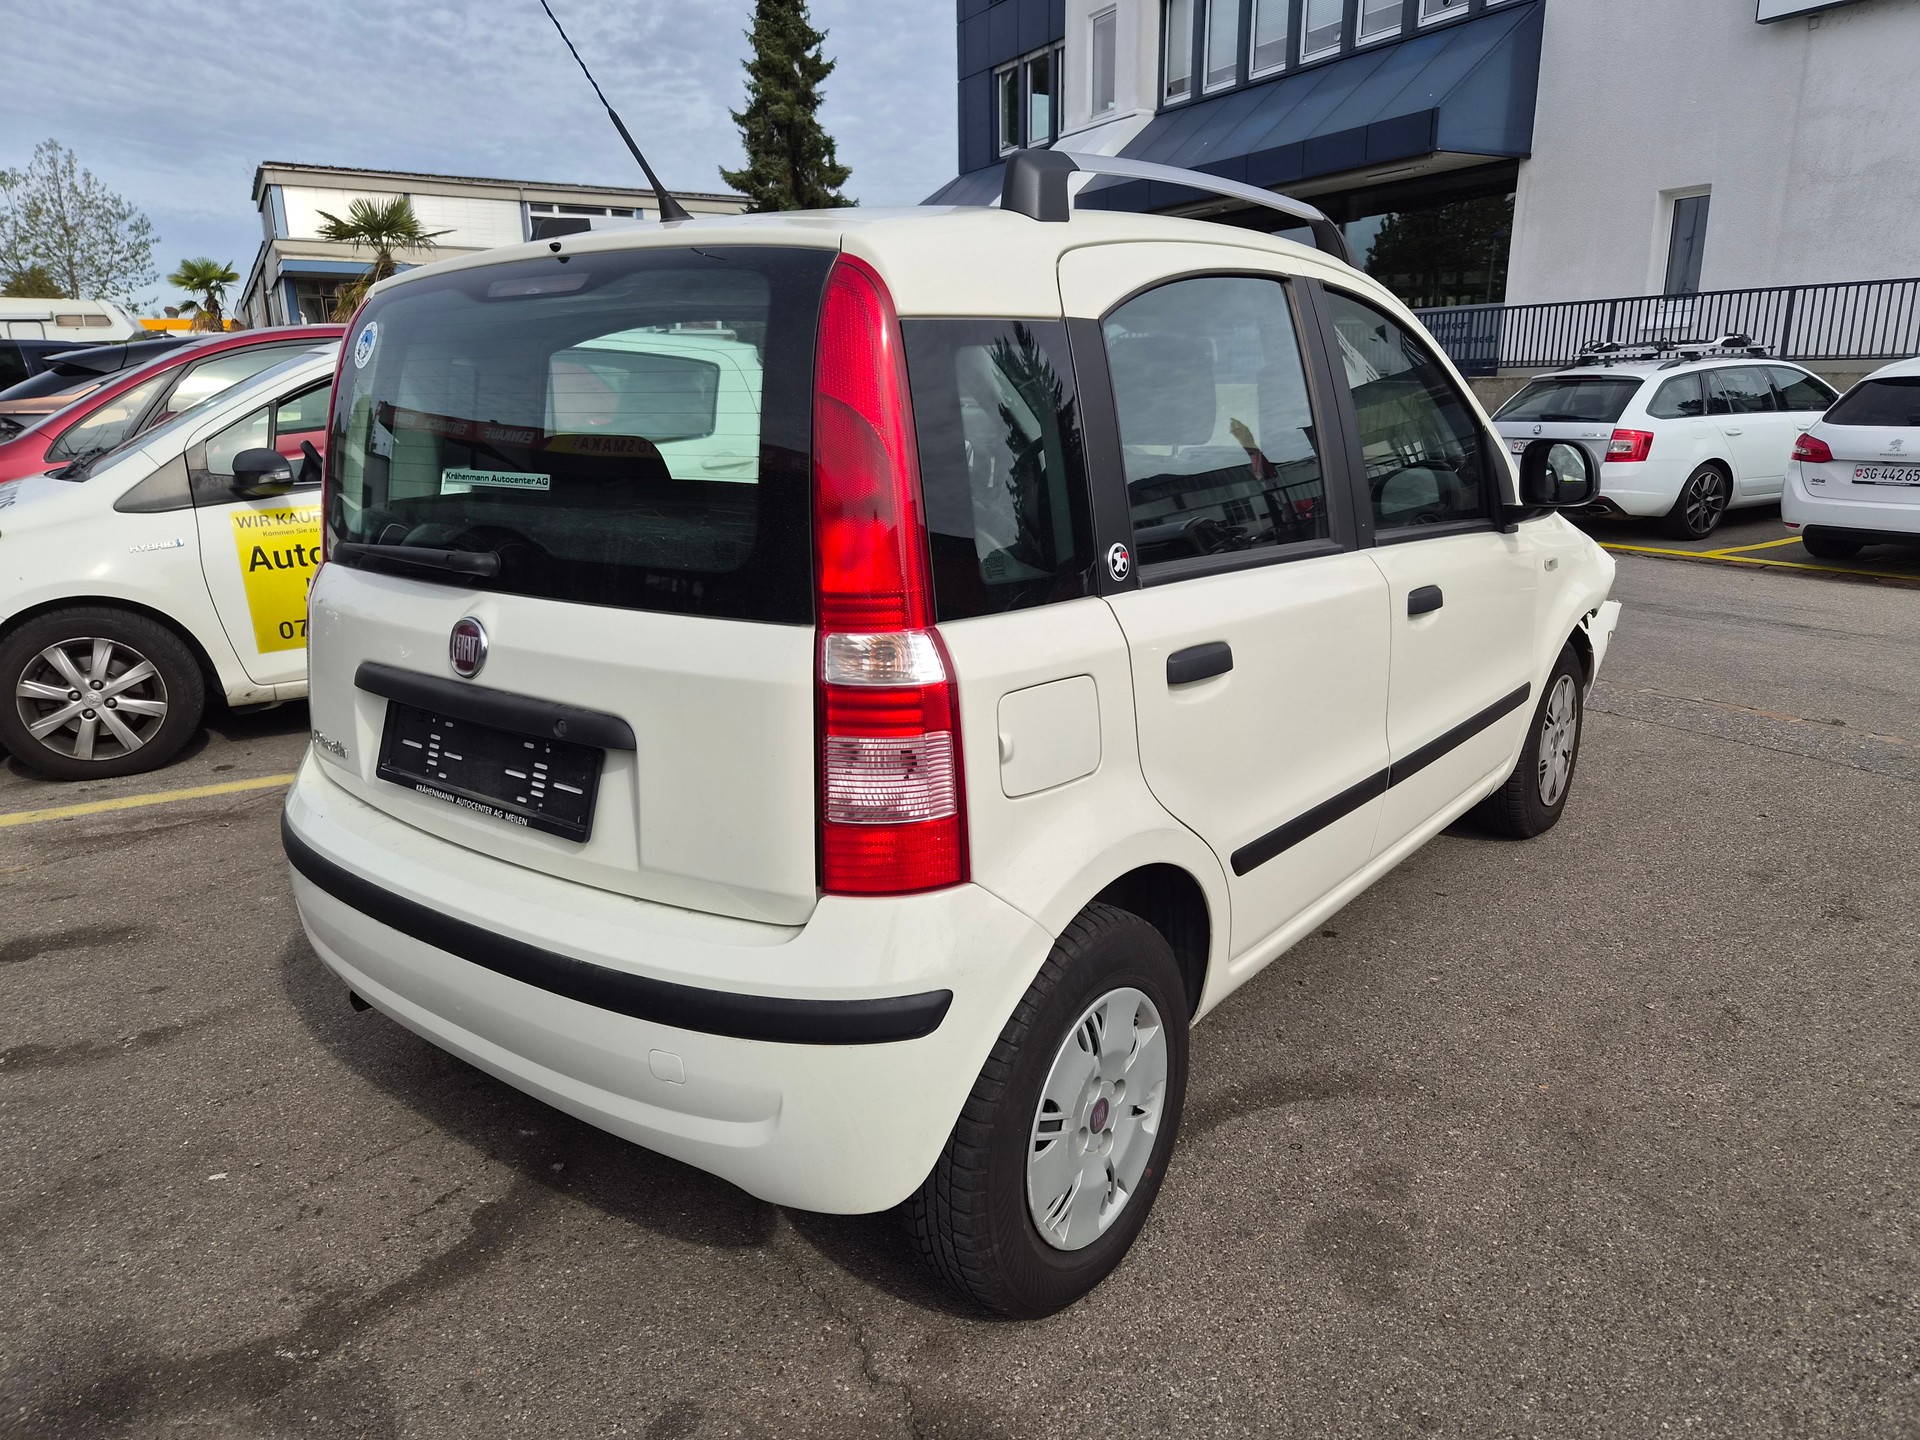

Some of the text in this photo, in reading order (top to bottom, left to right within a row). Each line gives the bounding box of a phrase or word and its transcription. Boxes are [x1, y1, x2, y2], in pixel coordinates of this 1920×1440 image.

[491, 474, 535, 485] Autocenter
[535, 477, 549, 486] AG
[236, 514, 271, 529] WIR
[262, 529, 295, 537] Kommen
[296, 527, 308, 535] Sie
[130, 540, 176, 553] HYBRID
[456, 633, 478, 663] FIAT
[455, 796, 493, 815] AUTOCENTER
[493, 808, 503, 819] AG
[504, 811, 528, 826] MEILEN
